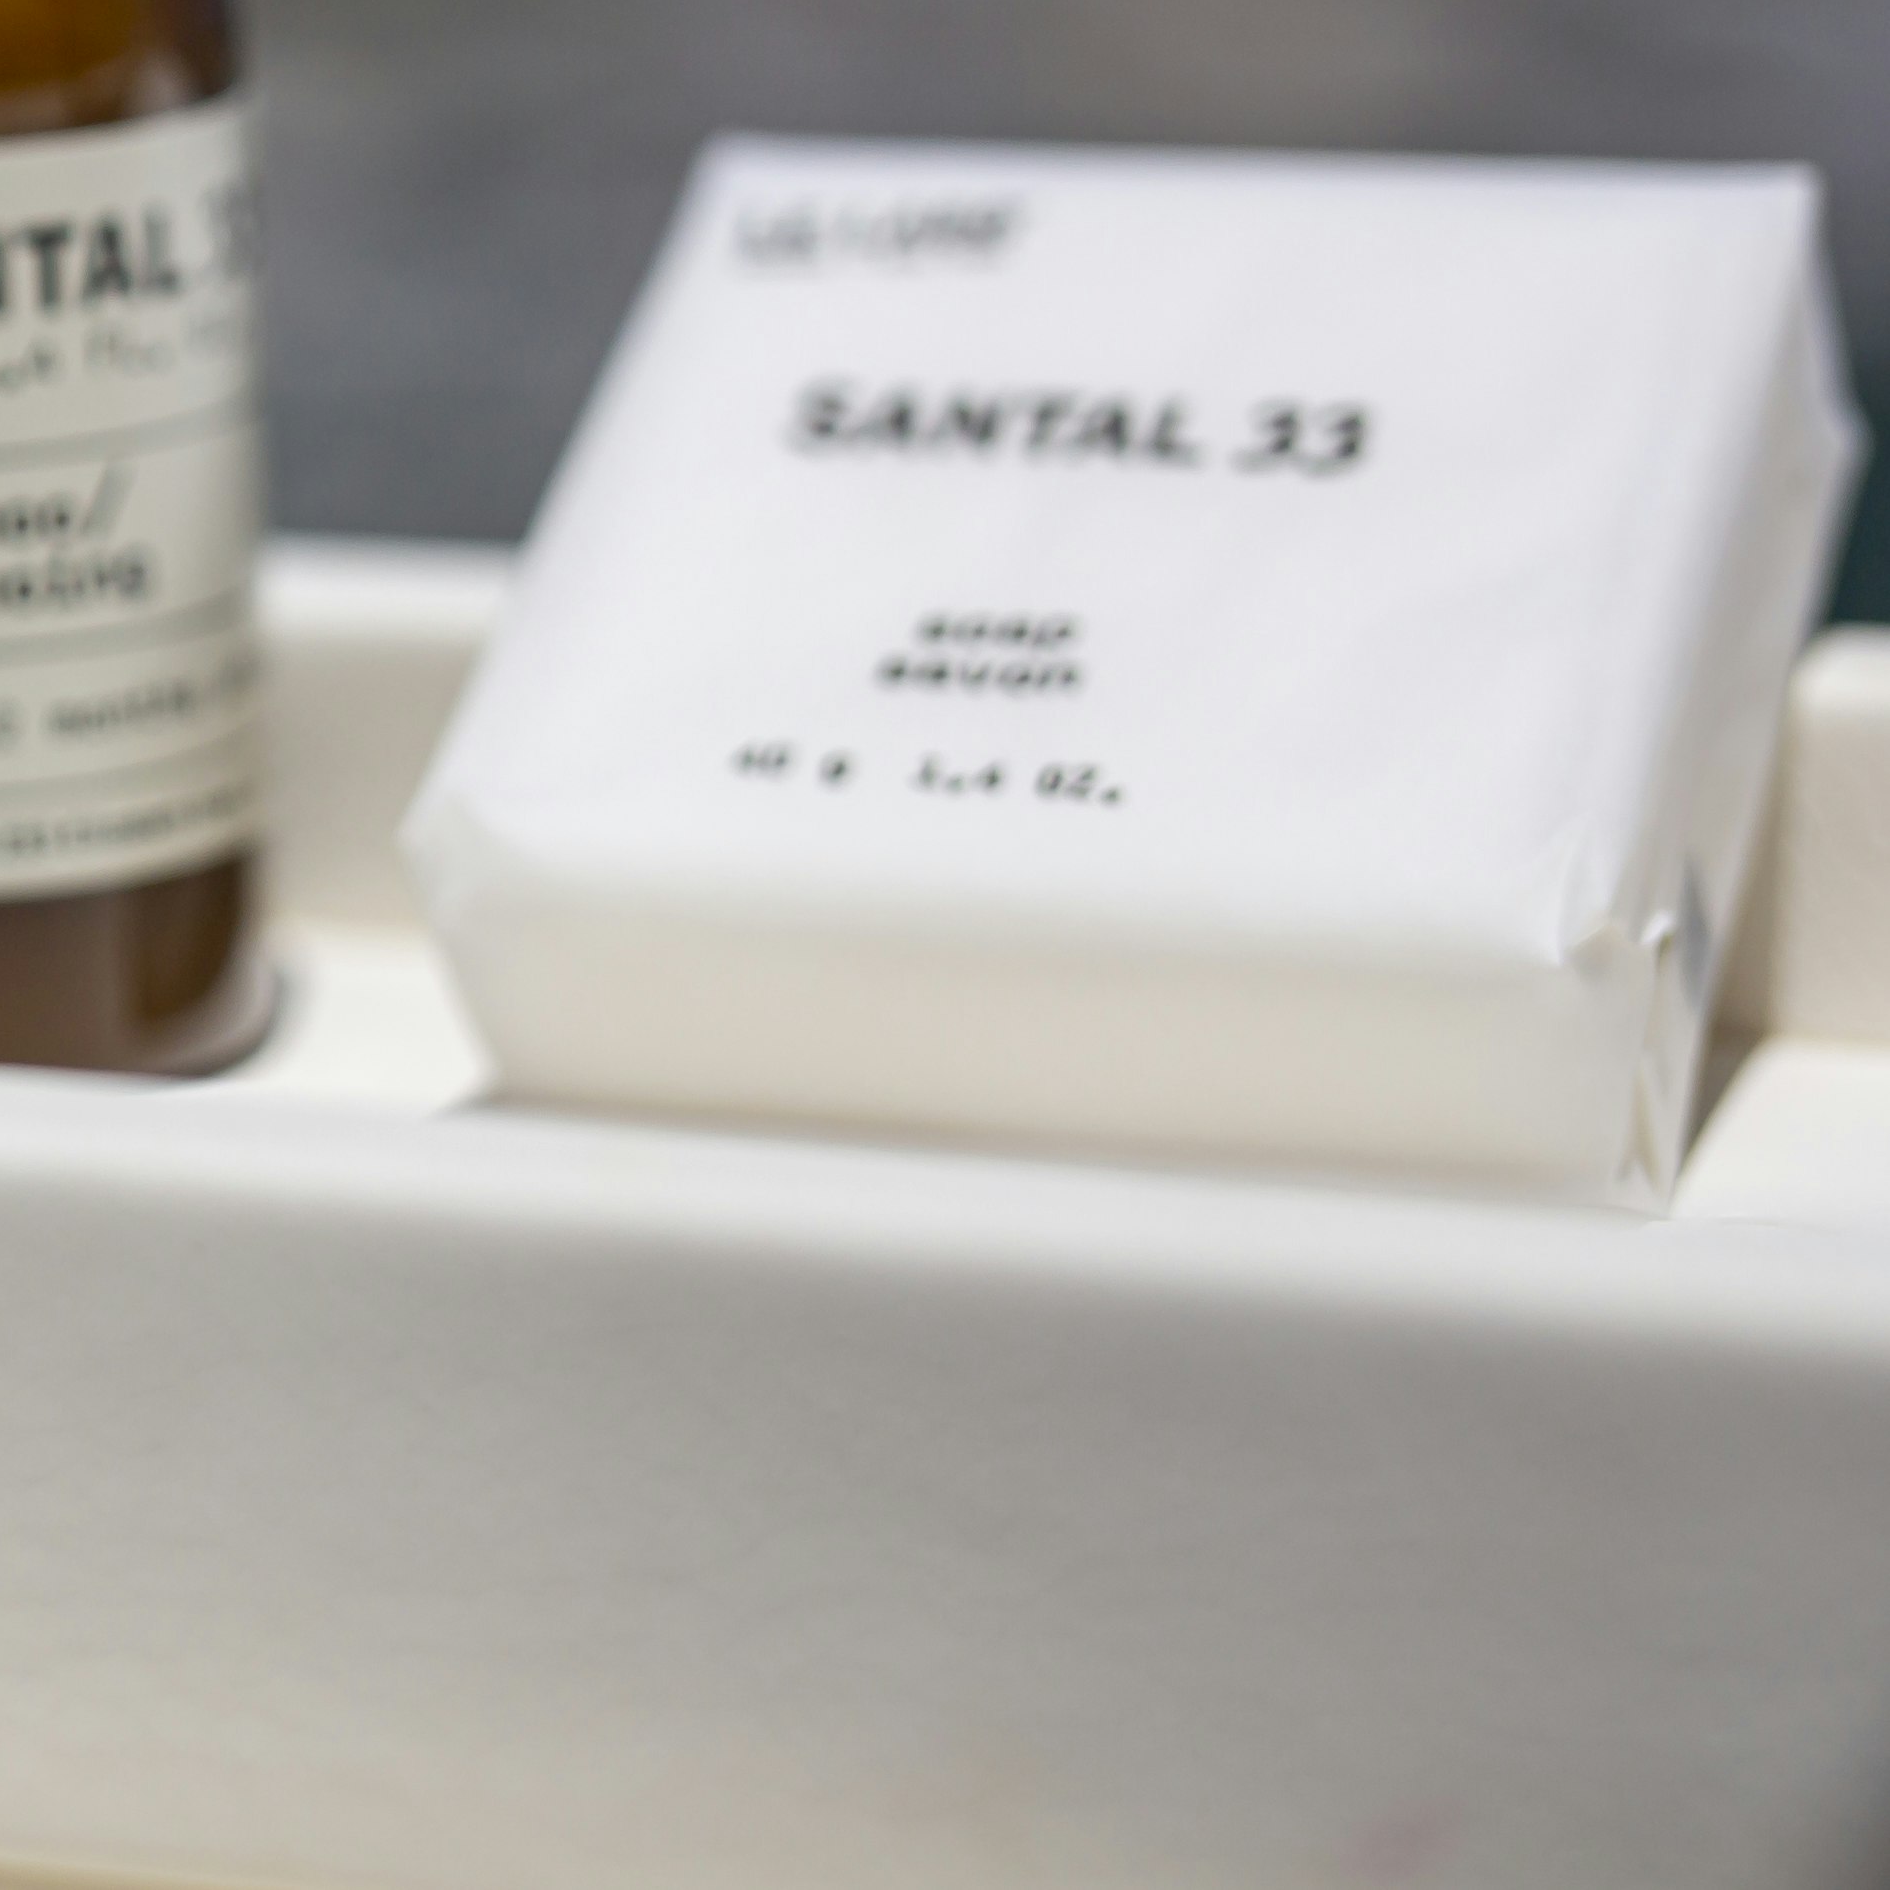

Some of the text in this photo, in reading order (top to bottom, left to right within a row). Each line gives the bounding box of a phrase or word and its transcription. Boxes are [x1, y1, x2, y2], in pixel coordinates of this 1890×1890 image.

[790, 376, 1372, 478] SANTAL 33
[1036, 762, 1126, 808] OZ.
